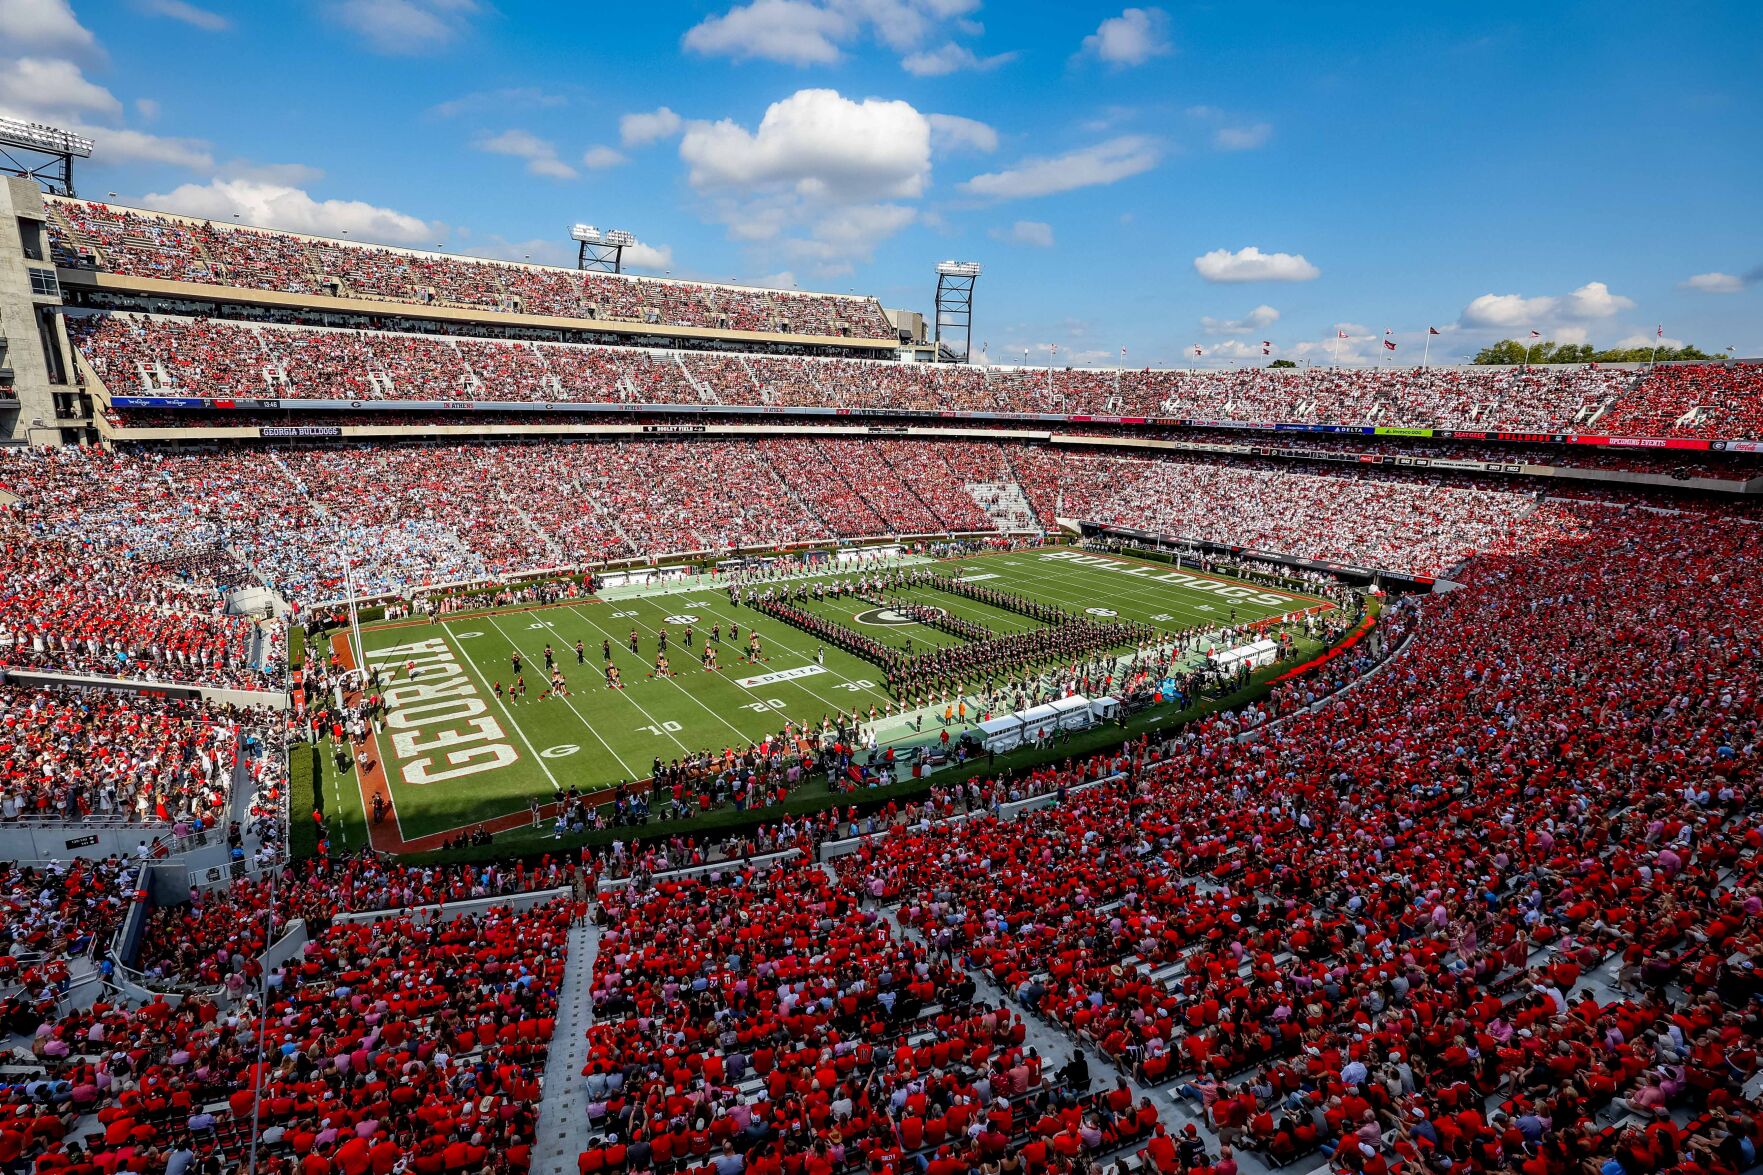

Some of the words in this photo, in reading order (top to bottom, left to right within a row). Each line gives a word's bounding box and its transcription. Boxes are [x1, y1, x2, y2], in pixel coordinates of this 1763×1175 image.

[299, 427, 338, 435] BULLDOGS
[1453, 431, 1487, 439] SEATGEEK
[1608, 437, 1640, 446] UPCOMING
[1640, 438, 1667, 447] EVENTS
[1041, 551, 1294, 606] BULLDOGS
[664, 615, 699, 624] SEC
[763, 667, 821, 682] DELTA
[840, 679, 876, 692] 30
[365, 638, 519, 784] GEORGIA
[748, 698, 787, 713] 20
[647, 720, 683, 735] 10
[539, 744, 581, 758] G
